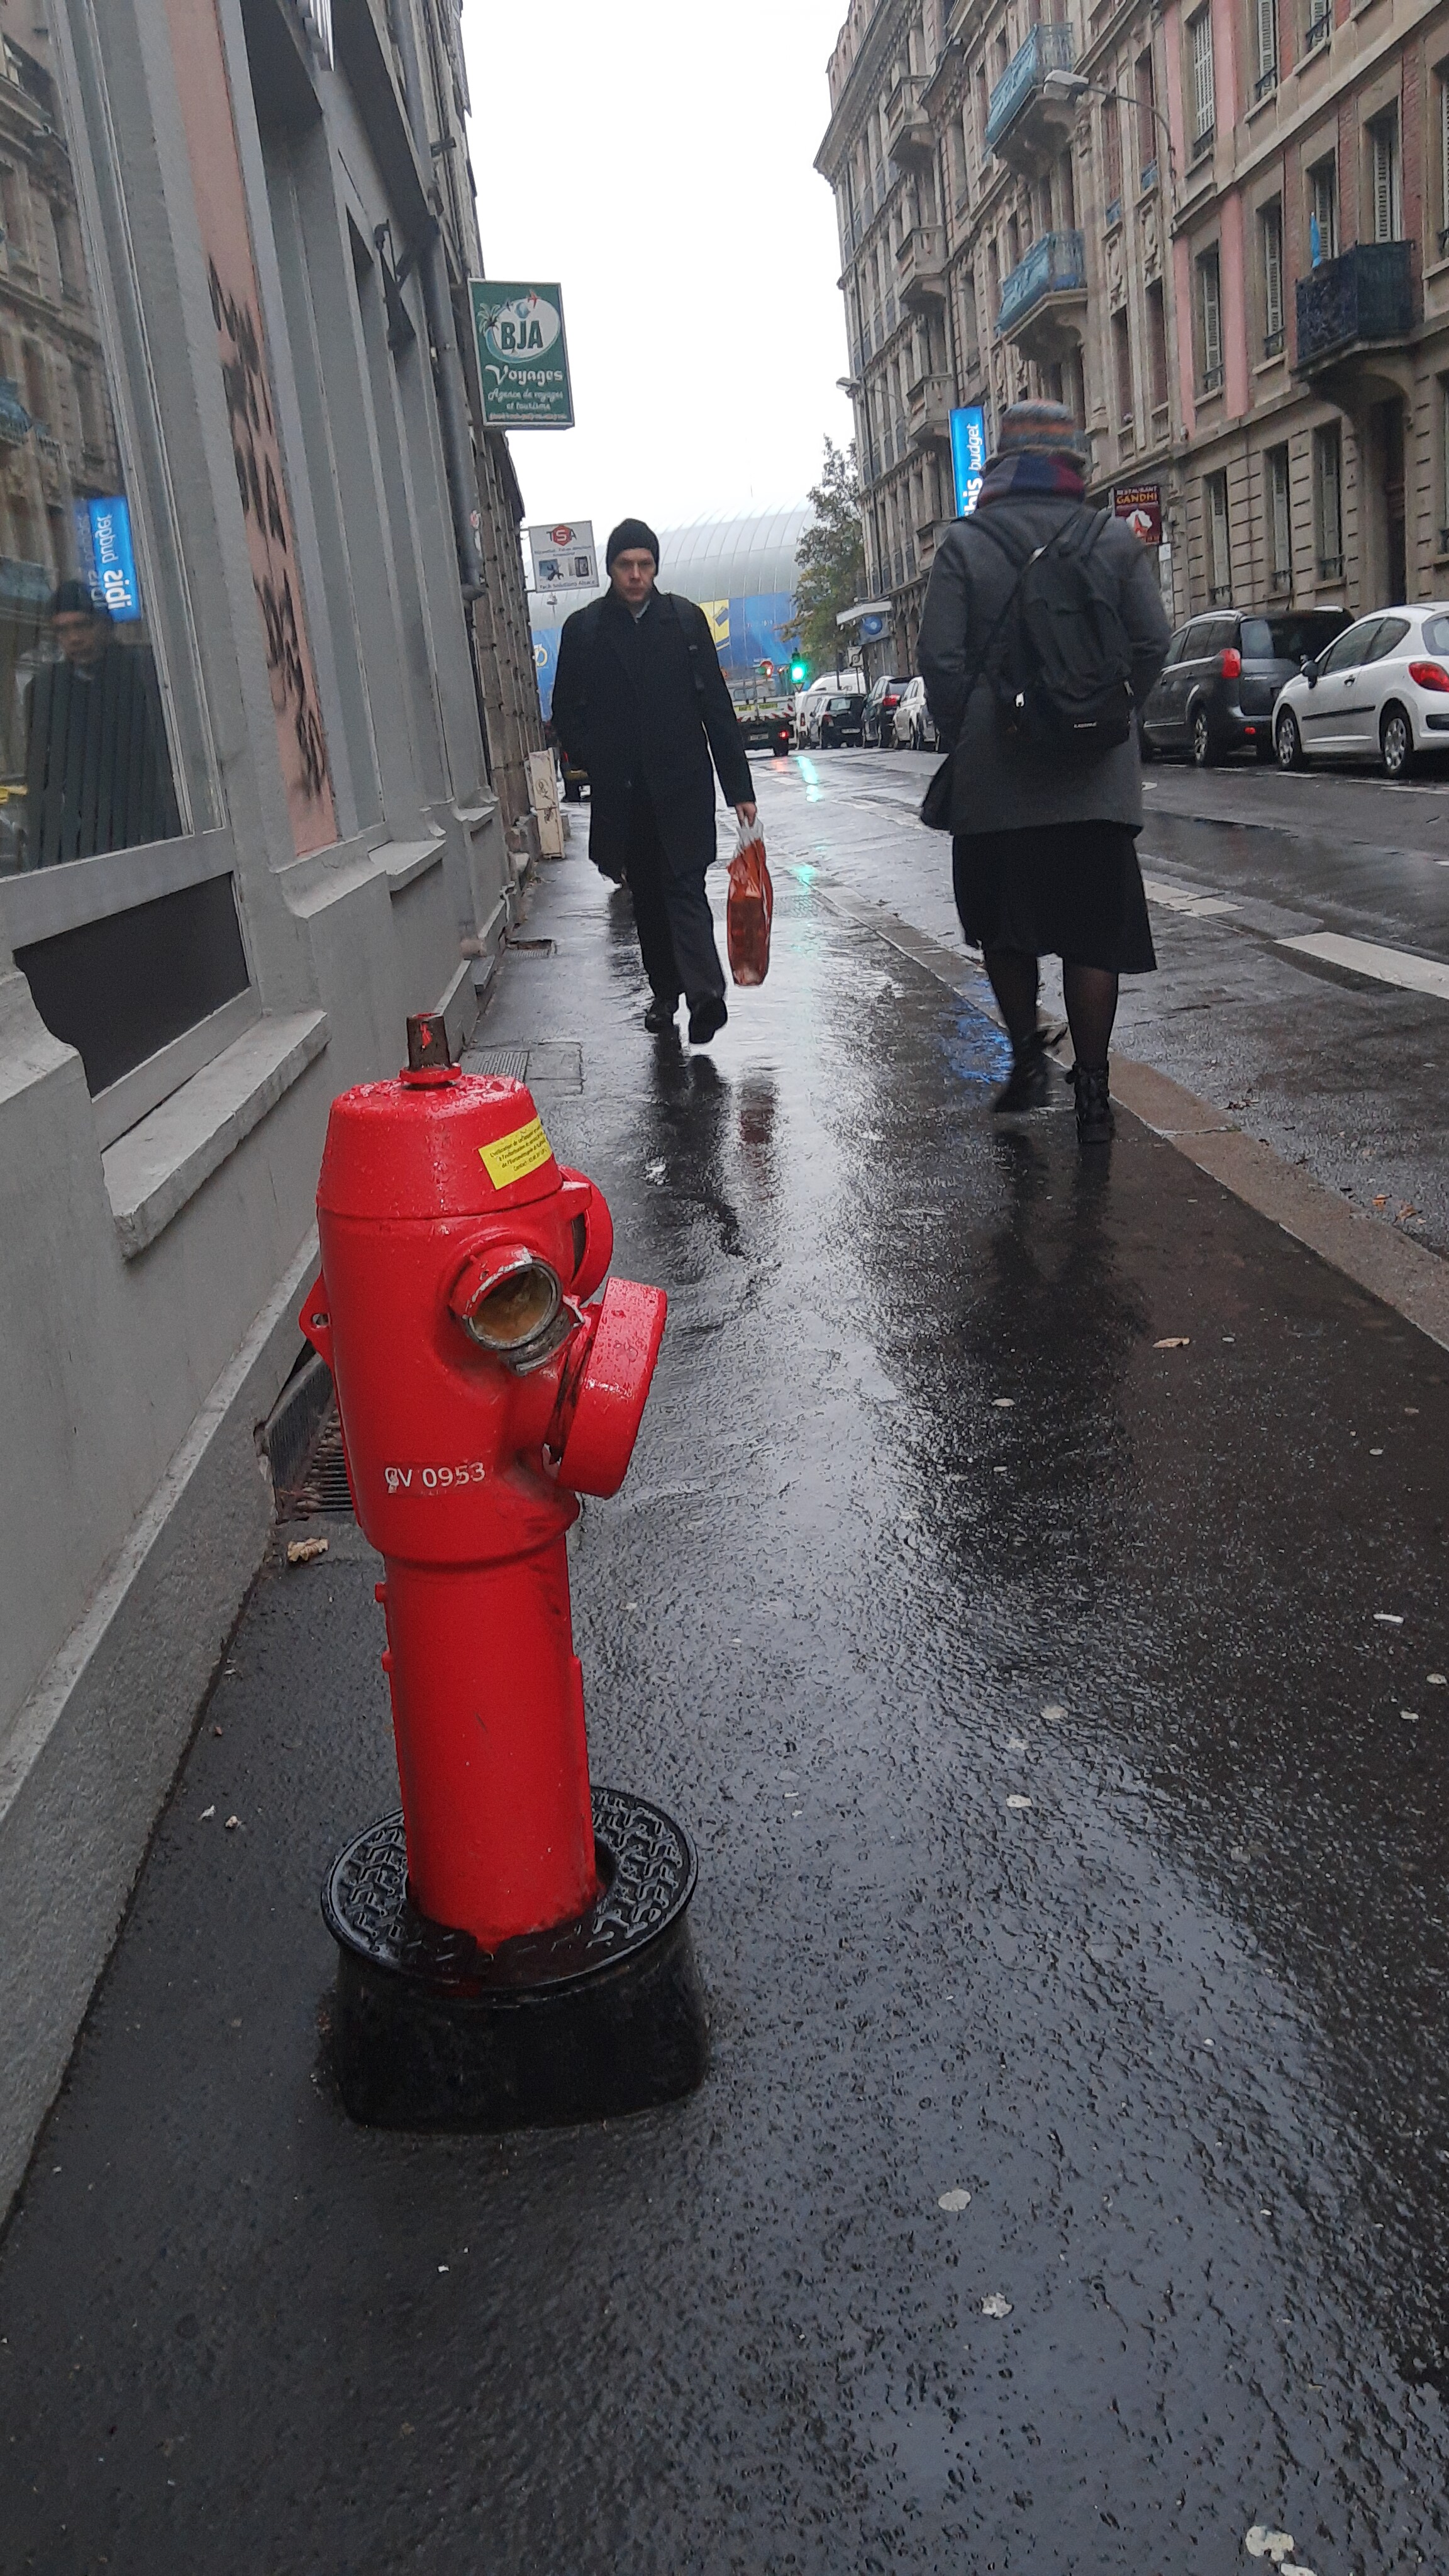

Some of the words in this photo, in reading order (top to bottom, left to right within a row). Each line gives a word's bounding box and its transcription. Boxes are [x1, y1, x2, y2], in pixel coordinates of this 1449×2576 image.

[501, 320, 543, 350] BJA
[485, 364, 563, 386] Voyages
[967, 423, 982, 471] budget
[1117, 492, 1157, 504] GANDHI
[546, 528, 577, 541] TSA
[422, 1461, 486, 1488] 0953
